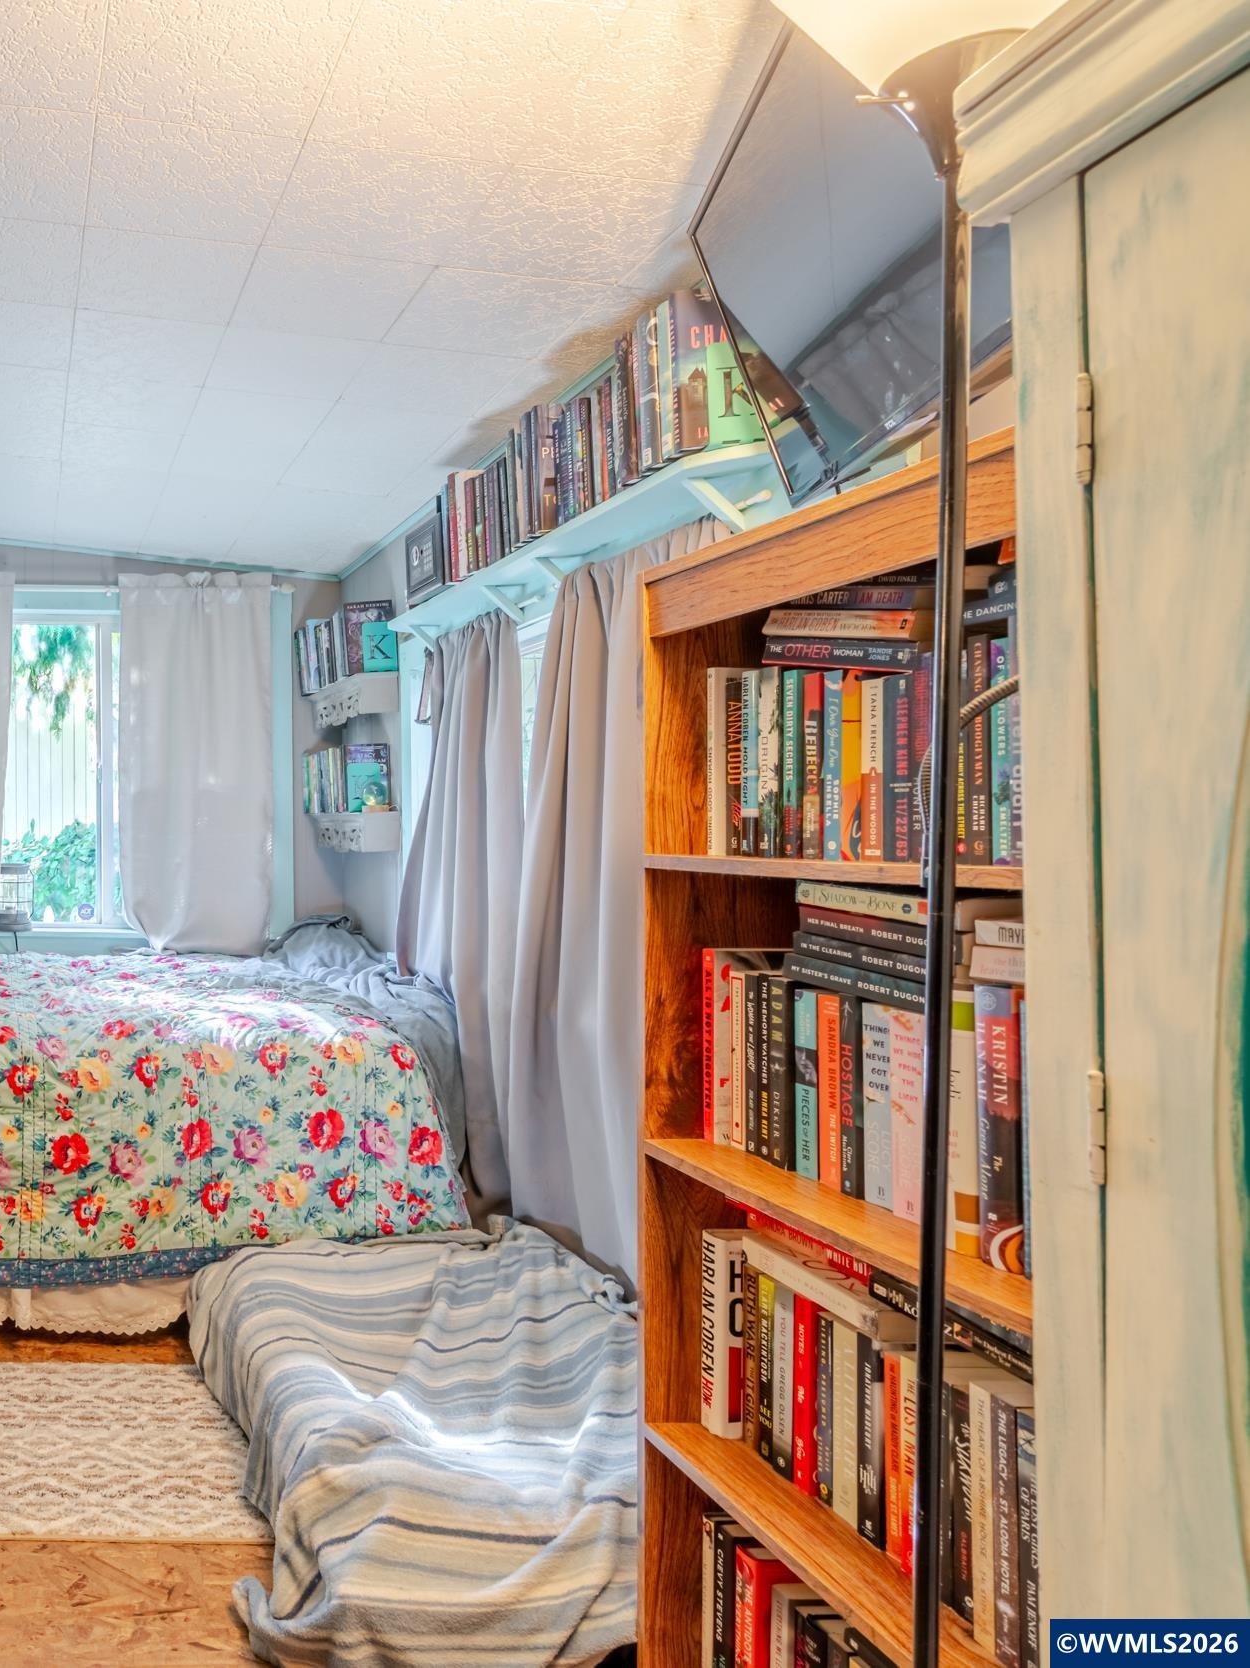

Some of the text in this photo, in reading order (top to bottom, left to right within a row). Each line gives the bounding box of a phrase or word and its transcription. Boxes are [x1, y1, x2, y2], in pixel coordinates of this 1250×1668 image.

[366, 634, 393, 660] K
[770, 643, 863, 659] THE OTHER WOMAN
[973, 642, 984, 692] CHASING
[785, 679, 794, 780] SEVEN DIRTY SECRETS
[870, 693, 878, 720] TANA
[728, 701, 743, 785] ANNA TODD
[805, 720, 818, 794] REBECCA
[895, 696, 909, 776] STEPHEN KING
[761, 736, 769, 791] ORIGIN
[870, 783, 877, 794] IN
[869, 813, 877, 847] WOODS
[998, 807, 1008, 856] SMELTZER
[819, 890, 897, 912] SHADOW BONE
[807, 917, 819, 925] HER
[820, 919, 839, 929] FINAL
[839, 923, 864, 933] BREATH
[871, 929, 903, 942] ROBERT
[791, 965, 927, 1004] MY SISTER'S GRAVE ROBERT DUGON
[809, 944, 820, 952] THE
[821, 946, 853, 959] CLEARING
[862, 955, 893, 969] ROBERT
[896, 962, 927, 976] DUGON
[705, 970, 713, 1110] ALL IS NOT FORGOTTEN
[771, 987, 783, 1043] ADAM
[828, 1018, 838, 1110] SANDRA BROWN
[872, 1039, 885, 1049] WE
[976, 1022, 988, 1102] HANNAH
[992, 1025, 1009, 1106] KRISTIN
[841, 1043, 854, 1128] HOSTAGE
[868, 1081, 890, 1092] OVER
[871, 1067, 888, 1077] GOT
[902, 1078, 915, 1088] THE
[772, 1091, 781, 1138] DEKKER
[829, 1114, 837, 1163] THE SWITCH
[867, 1120, 881, 1173] SCORE
[979, 1117, 993, 1201] Great Alone
[993, 1155, 1004, 1172] The
[826, 1248, 851, 1269] WHITE
[702, 1239, 716, 1409] HARLAN COBEN HOME
[746, 1274, 757, 1361] RUTH WARE
[761, 1283, 769, 1384] CLARE MACKINTOSH
[797, 1323, 805, 1355] MOYES
[778, 1365, 787, 1437] GREGG OLSEN
[907, 1379, 917, 1397] THE
[904, 1441, 916, 1478] MAN
[1020, 1486, 1031, 1544] OF PARIS
[715, 1548, 724, 1643] CHEVY STEVENS
[1026, 1579, 1037, 1650] PAM JENOFF
[743, 1584, 754, 1665] THE ANTIDOTE
